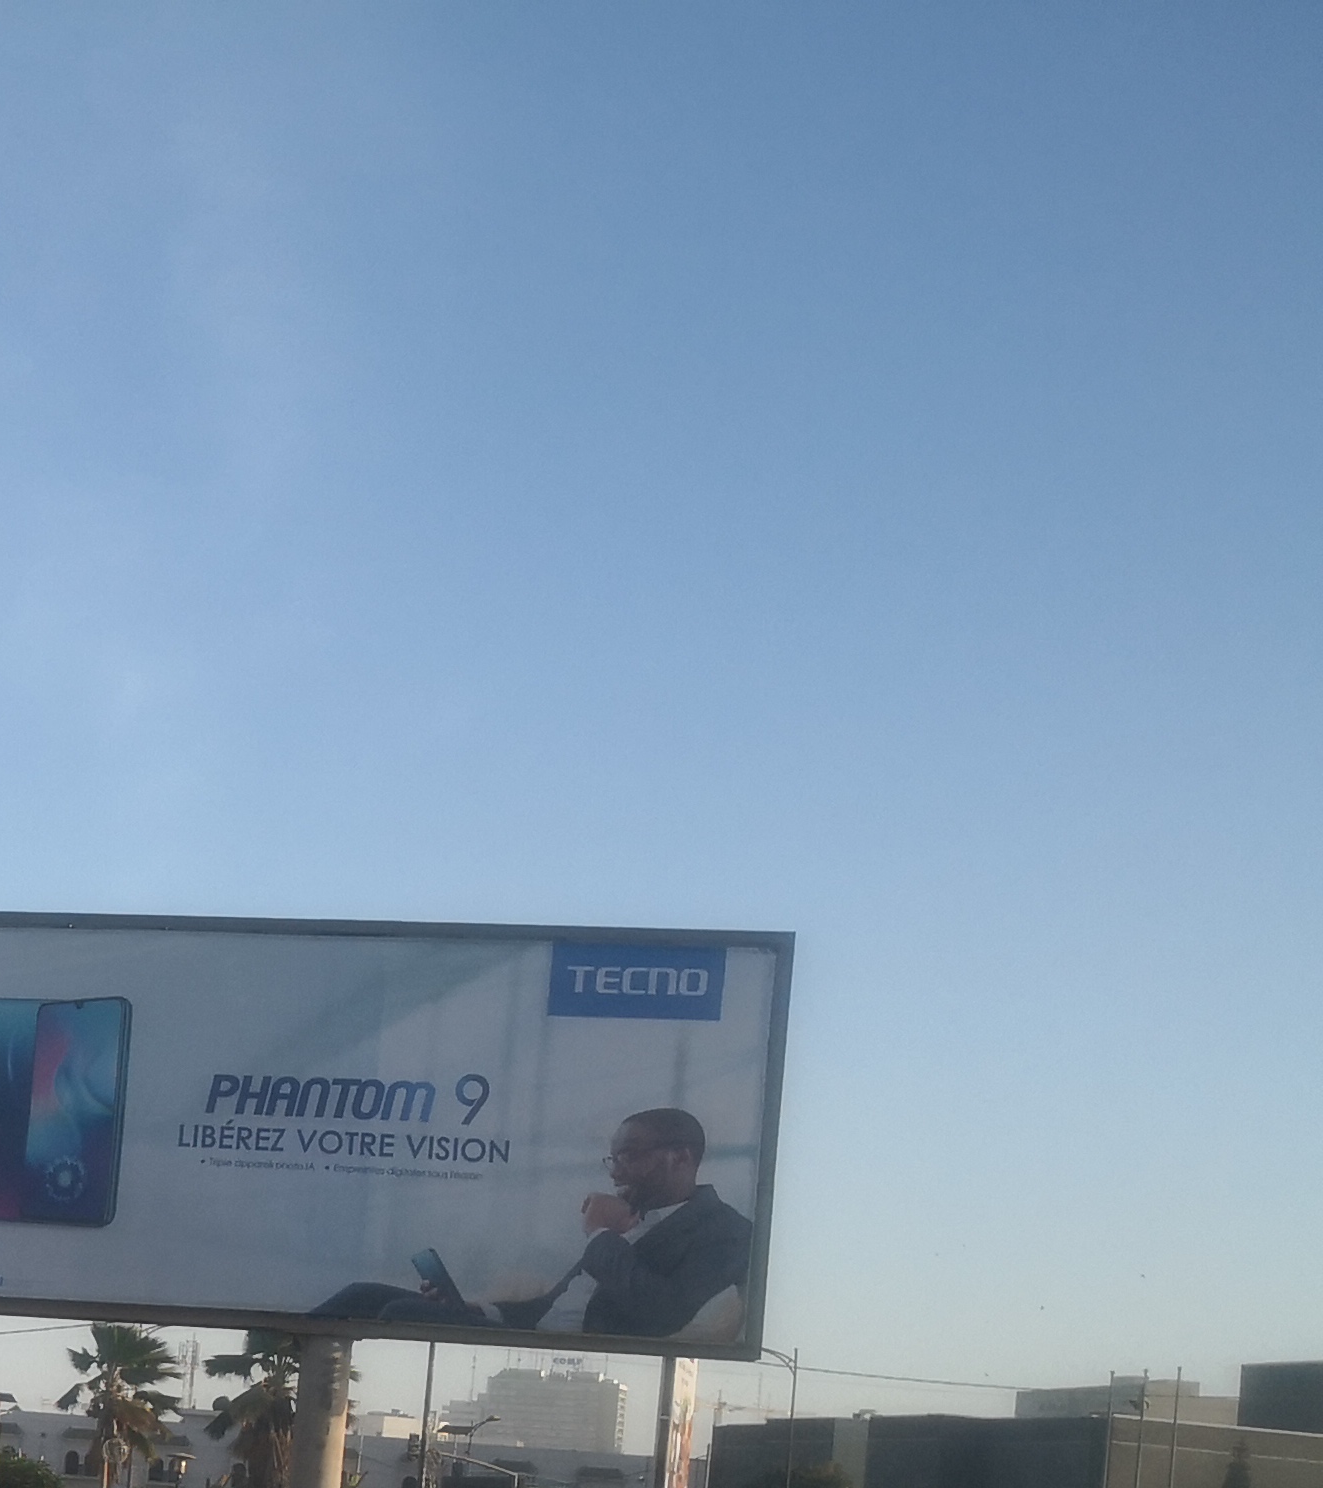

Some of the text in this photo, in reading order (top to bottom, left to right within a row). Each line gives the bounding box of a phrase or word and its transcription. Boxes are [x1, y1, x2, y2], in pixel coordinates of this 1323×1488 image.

[567, 965, 709, 996] TECNO
[204, 1073, 491, 1126] PHANTOM 9
[177, 1119, 512, 1164] LIBÉREZ VOTRE VISION
